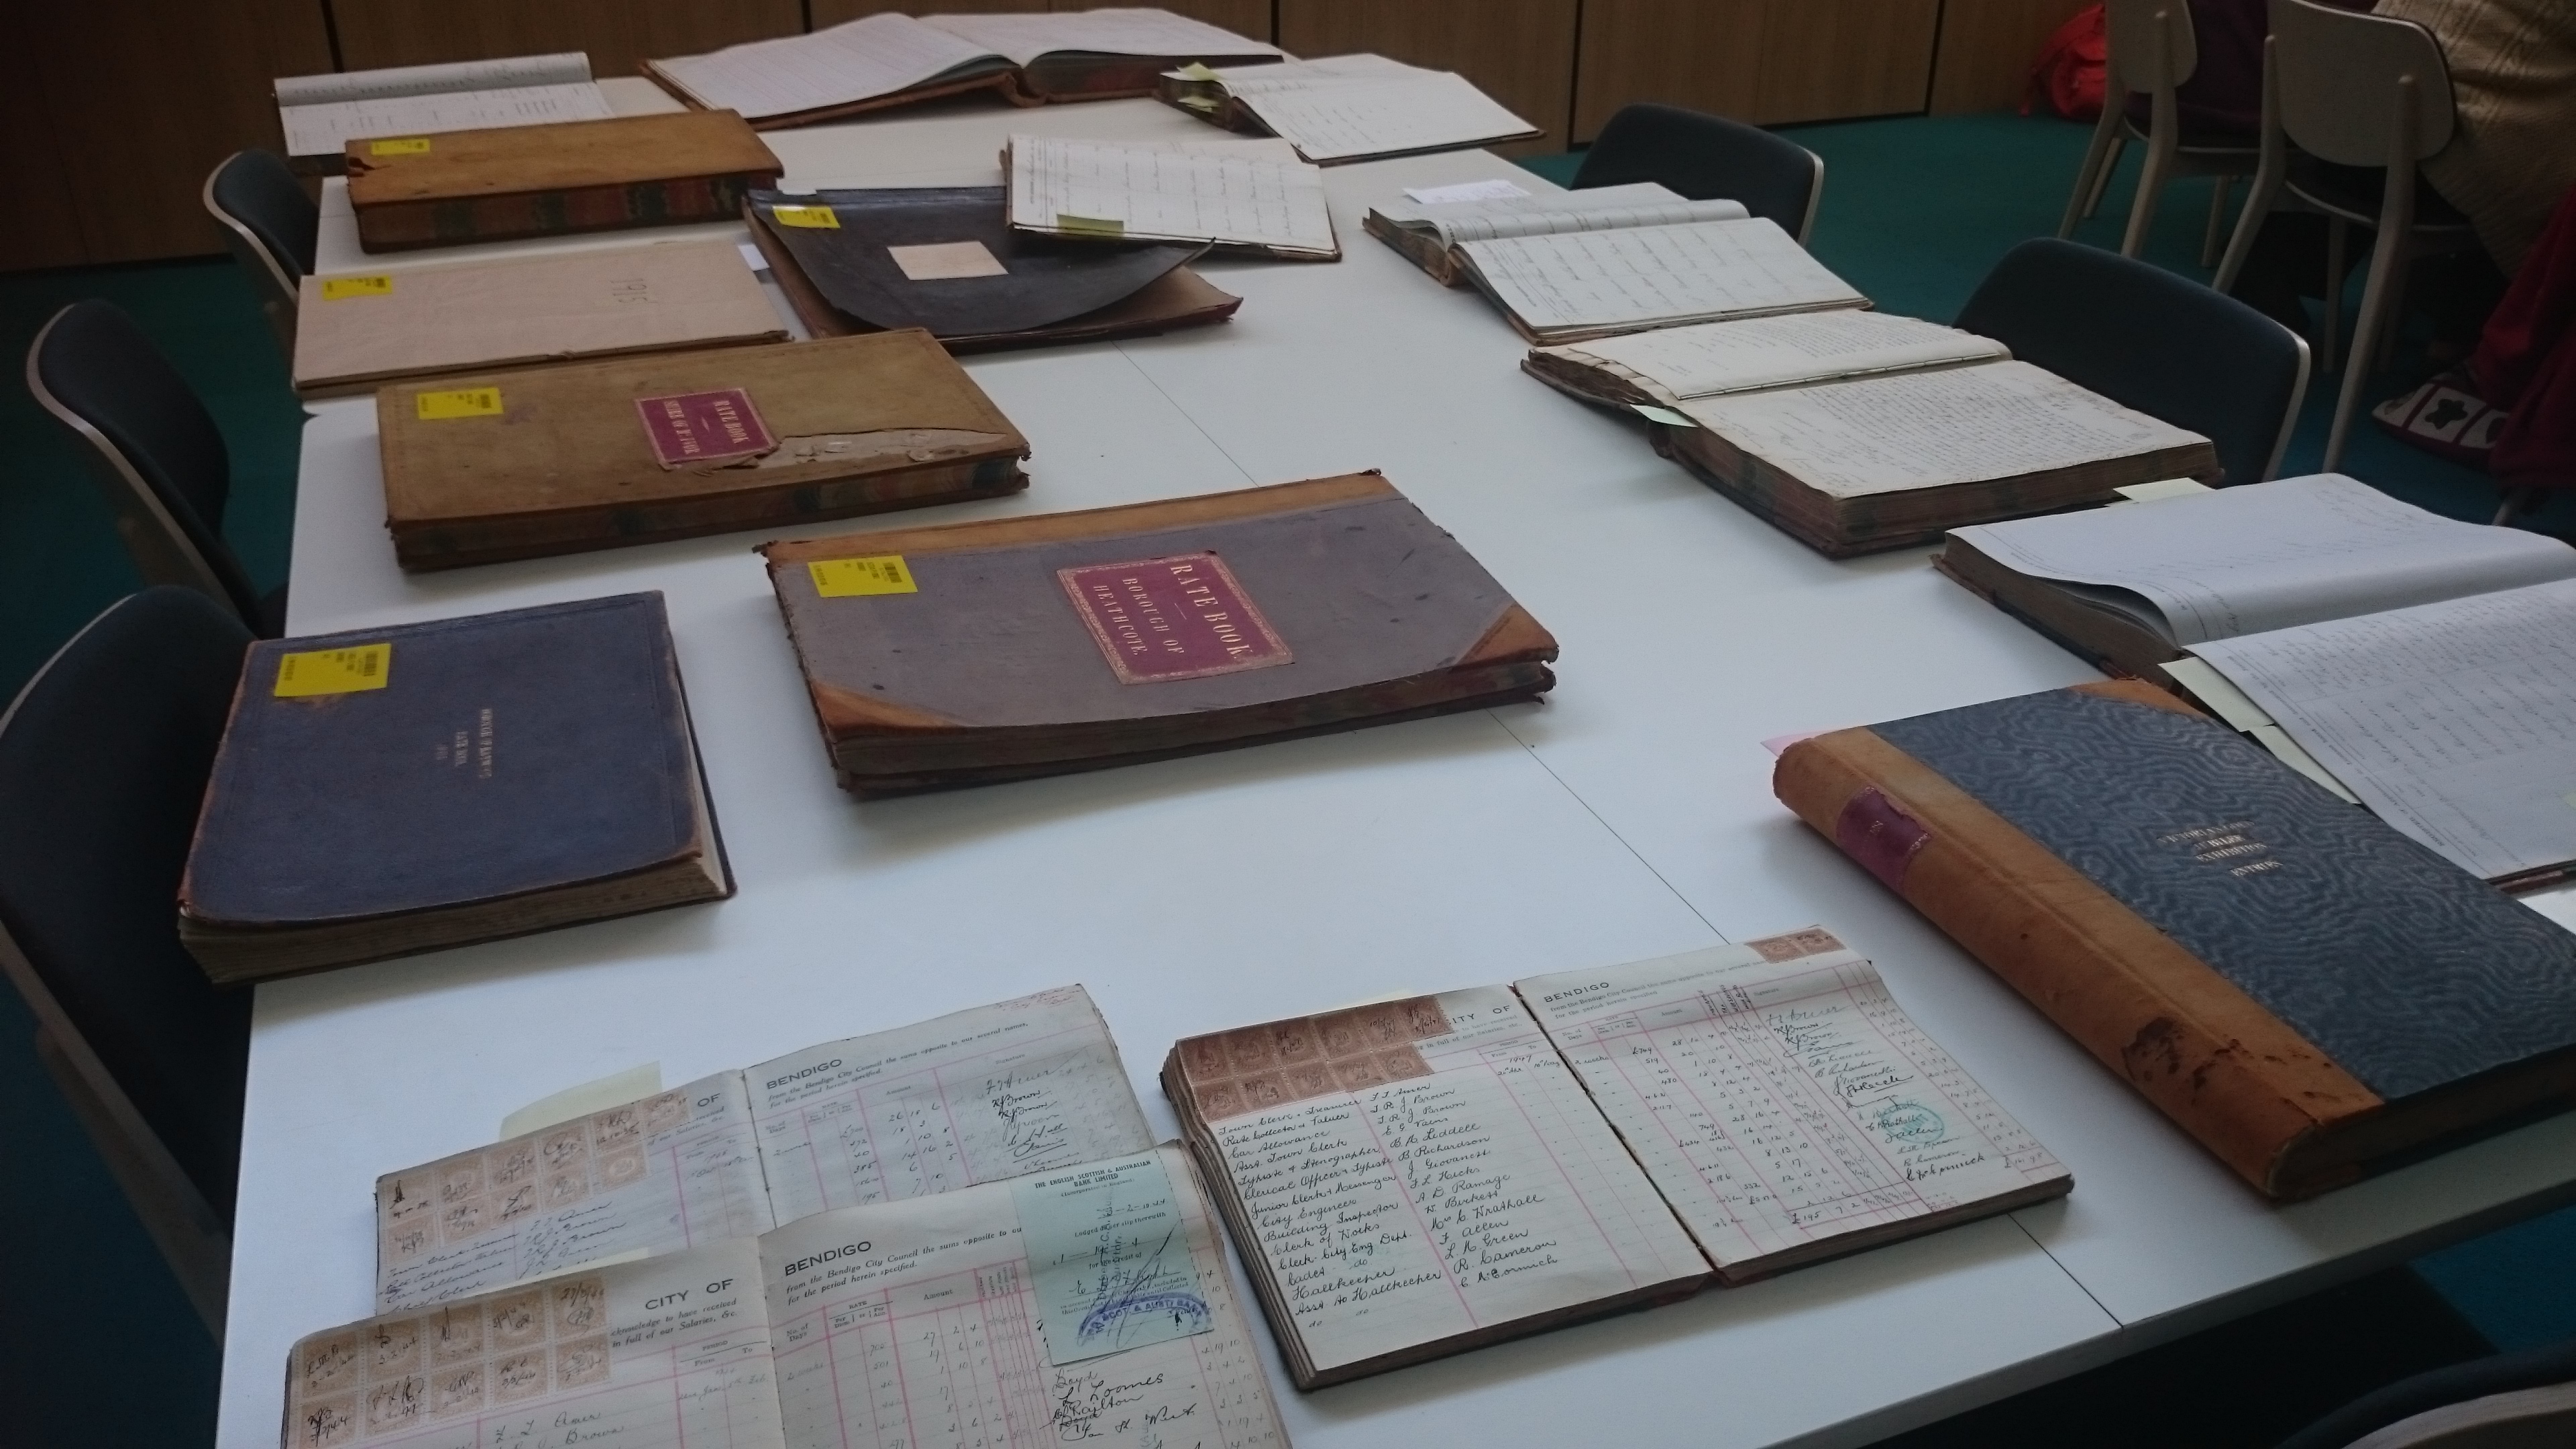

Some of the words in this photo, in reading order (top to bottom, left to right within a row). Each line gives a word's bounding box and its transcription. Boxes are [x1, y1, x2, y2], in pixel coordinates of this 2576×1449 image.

[713, 400, 739, 422] RATE
[724, 423, 749, 443] BOOK
[1170, 564, 1219, 607] RATE
[1122, 578, 1171, 633] BOROUGH
[1163, 639, 1185, 655] OF
[2194, 841, 2268, 863] EXHIBITION
[1544, 981, 1609, 1004] BENDIGO
[1550, 1004, 1567, 1012] from
[1579, 994, 1606, 1005] Bendigo
[1621, 985, 1646, 994] Council
[1493, 1005, 1511, 1014] OF
[1582, 1000, 1604, 1014] period
[1607, 998, 1627, 1007] herein
[1660, 1008, 1683, 1017] Amount
[1436, 1038, 1450, 1046] full
[768, 1091, 788, 1103] from
[805, 1076, 835, 1089] Bendigo
[838, 1071, 853, 1079] City
[856, 1060, 883, 1073] Council
[920, 1043, 948, 1055] opposite
[977, 1028, 1002, 1039] several
[1005, 1022, 1030, 1032] names.
[767, 1059, 843, 1090] BENDIGO
[697, 1092, 721, 1108] OF
[769, 1101, 782, 1110] for
[800, 1087, 822, 1100] period
[826, 1080, 849, 1091] herein
[885, 1085, 912, 1096] Amount
[1413, 1087, 1456, 1104] Brown
[1422, 1099, 1466, 1115] Brown
[1218, 1122, 1254, 1136] Town
[1258, 1112, 1295, 1126] Clerk
[1422, 1122, 1482, 1141] Liddell
[1222, 1132, 1252, 1148] Rate
[1252, 1125, 1297, 1141] Collector
[1258, 1130, 1330, 1154] Allowance
[1413, 1134, 1491, 1157] Richardson
[1267, 1149, 1303, 1165] Town
[1307, 1140, 1348, 1153] Clerk
[1034, 1181, 1046, 1189] THE
[1049, 1175, 1075, 1187] ENGLISH
[1077, 1169, 1106, 1179] SCOTTISH
[1115, 1160, 1152, 1173] AUSTRALIAN
[1073, 1179, 1092, 1187] BANK
[1095, 1173, 1119, 1183] LIMITED
[1244, 1180, 1296, 1200] Clerical
[1299, 1170, 1342, 1190] Officer
[1438, 1167, 1481, 1181] Hicks
[1452, 1174, 1511, 1194] Ramage
[1250, 1198, 1289, 1220] Junior
[1291, 1191, 1328, 1205] Clerk
[1334, 1175, 1397, 1195] Messenger
[1474, 1193, 1546, 1219] Wrathall
[1075, 1227, 1099, 1238] Lodged
[1134, 1211, 1167, 1223] therewith
[1258, 1216, 1293, 1230] City
[1297, 1198, 1358, 1220] Engineer
[1263, 1222, 1329, 1243] Building
[1336, 1202, 1399, 1226] Inspector
[1271, 1241, 1315, 1256] Clerk
[1320, 1233, 1334, 1249] of
[1340, 1223, 1381, 1241] Works
[1482, 1228, 1529, 1247] Green
[784, 1240, 872, 1277] BENDIGO
[786, 1281, 806, 1295] from
[810, 1275, 822, 1285] the
[827, 1265, 861, 1279] Bendigo
[865, 1260, 883, 1269] City
[887, 1248, 919, 1263] Council
[922, 1246, 935, 1255] the
[939, 1241, 959, 1250] sums
[963, 1233, 996, 1245] opposite
[999, 1230, 1008, 1238] to
[1322, 1246, 1349, 1260] City
[1480, 1239, 1557, 1264] Cameron
[788, 1295, 800, 1306] for
[804, 1287, 817, 1298] the
[821, 1277, 847, 1293] period
[851, 1271, 876, 1283] herein
[880, 1260, 918, 1276] specified.
[1287, 1266, 1326, 1287] Cadet
[1292, 1267, 1396, 1301] Hallkeeper
[1352, 1269, 1442, 1302] Hallkeeper
[645, 1289, 690, 1310] CITY
[706, 1278, 734, 1294] OF
[849, 1300, 868, 1310] RATE
[923, 1289, 954, 1301] Amount
[678, 1309, 698, 1320] have
[702, 1297, 737, 1312] received
[612, 1340, 621, 1348] in
[625, 1332, 643, 1346] full
[646, 1330, 656, 1340] of
[659, 1327, 674, 1336] our
[679, 1316, 716, 1331] Salaries,
[786, 1329, 799, 1338] No.
[800, 1323, 809, 1331] of
[789, 1332, 808, 1342] Days
[694, 1356, 716, 1367] From
[1090, 1373, 1164, 1402] Loomes
